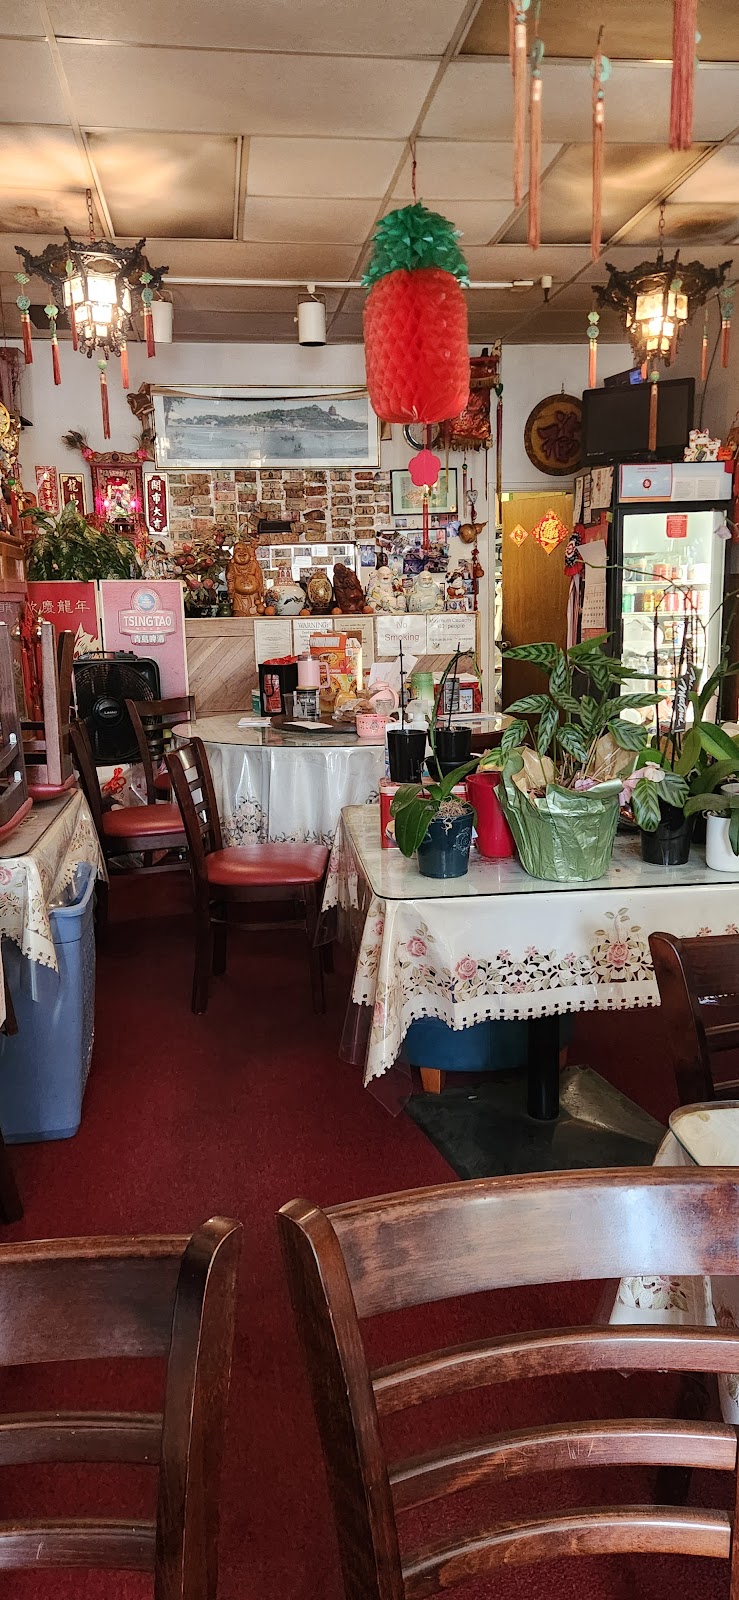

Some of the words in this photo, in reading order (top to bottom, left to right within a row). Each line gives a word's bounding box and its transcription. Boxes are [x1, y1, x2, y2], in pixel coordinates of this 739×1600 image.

[123, 615, 172, 627] TSINGTAO
[396, 620, 408, 629] No
[384, 633, 420, 643] Smoking
